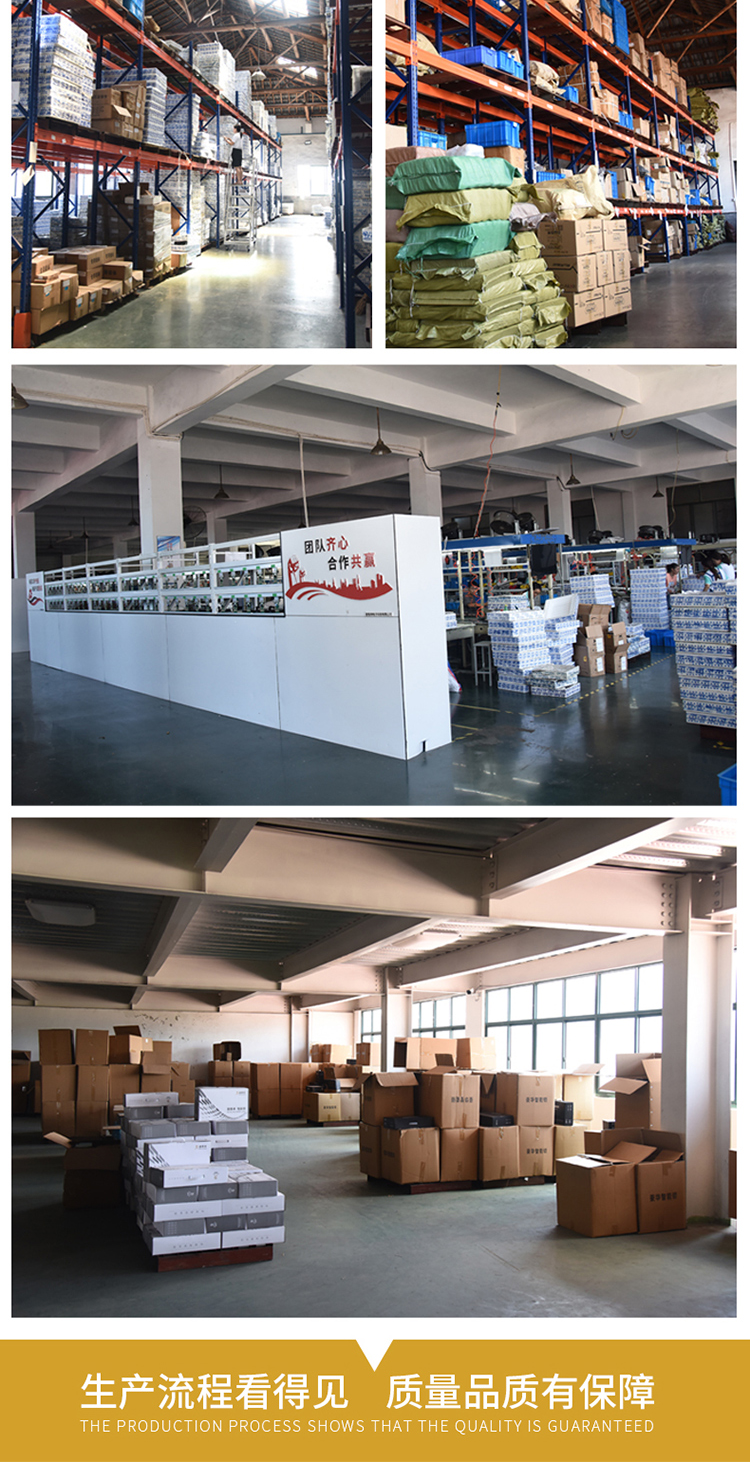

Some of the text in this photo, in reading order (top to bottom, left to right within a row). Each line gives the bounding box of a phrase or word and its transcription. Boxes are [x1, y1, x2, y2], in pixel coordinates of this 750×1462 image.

[304, 535, 349, 554] 团队齐心
[327, 552, 376, 571] 合作共赢
